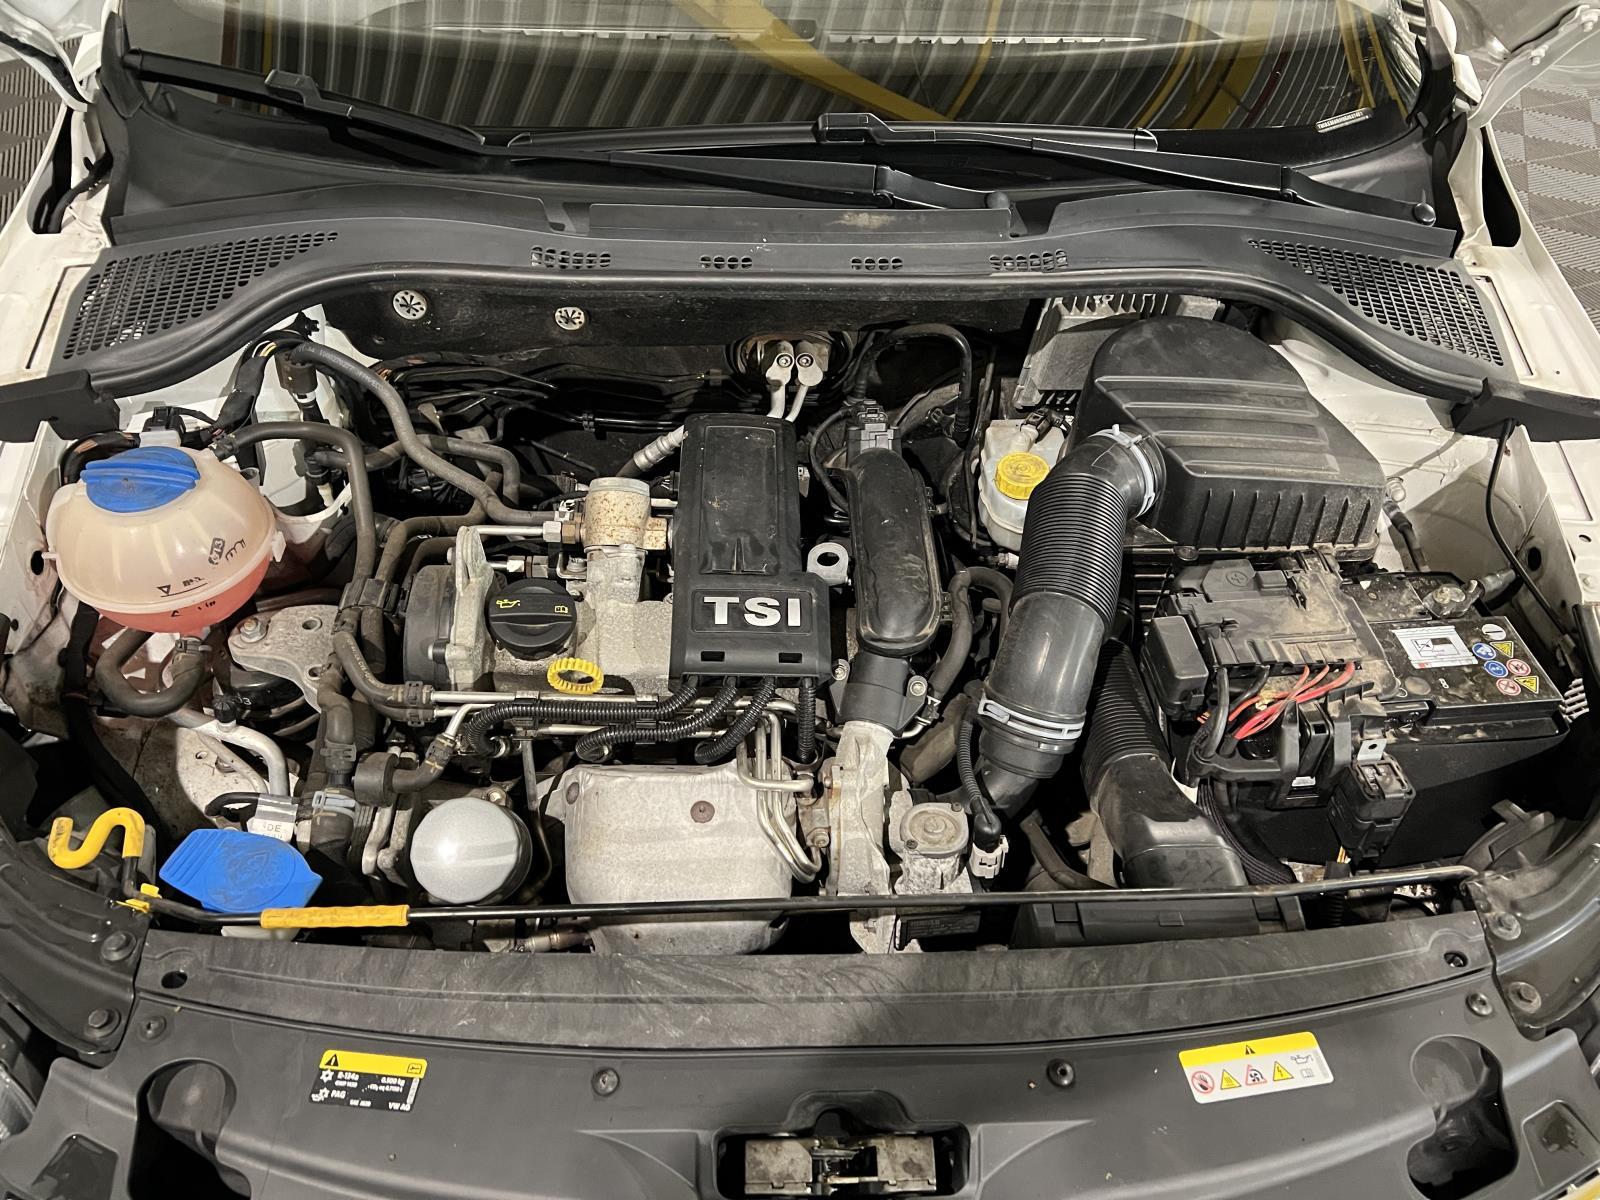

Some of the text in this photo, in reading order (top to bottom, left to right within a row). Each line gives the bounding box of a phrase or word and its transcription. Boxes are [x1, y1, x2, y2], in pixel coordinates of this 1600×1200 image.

[703, 596, 801, 627] TSI
[330, 1089, 346, 1099] PAG
[388, 1101, 400, 1110] VW
